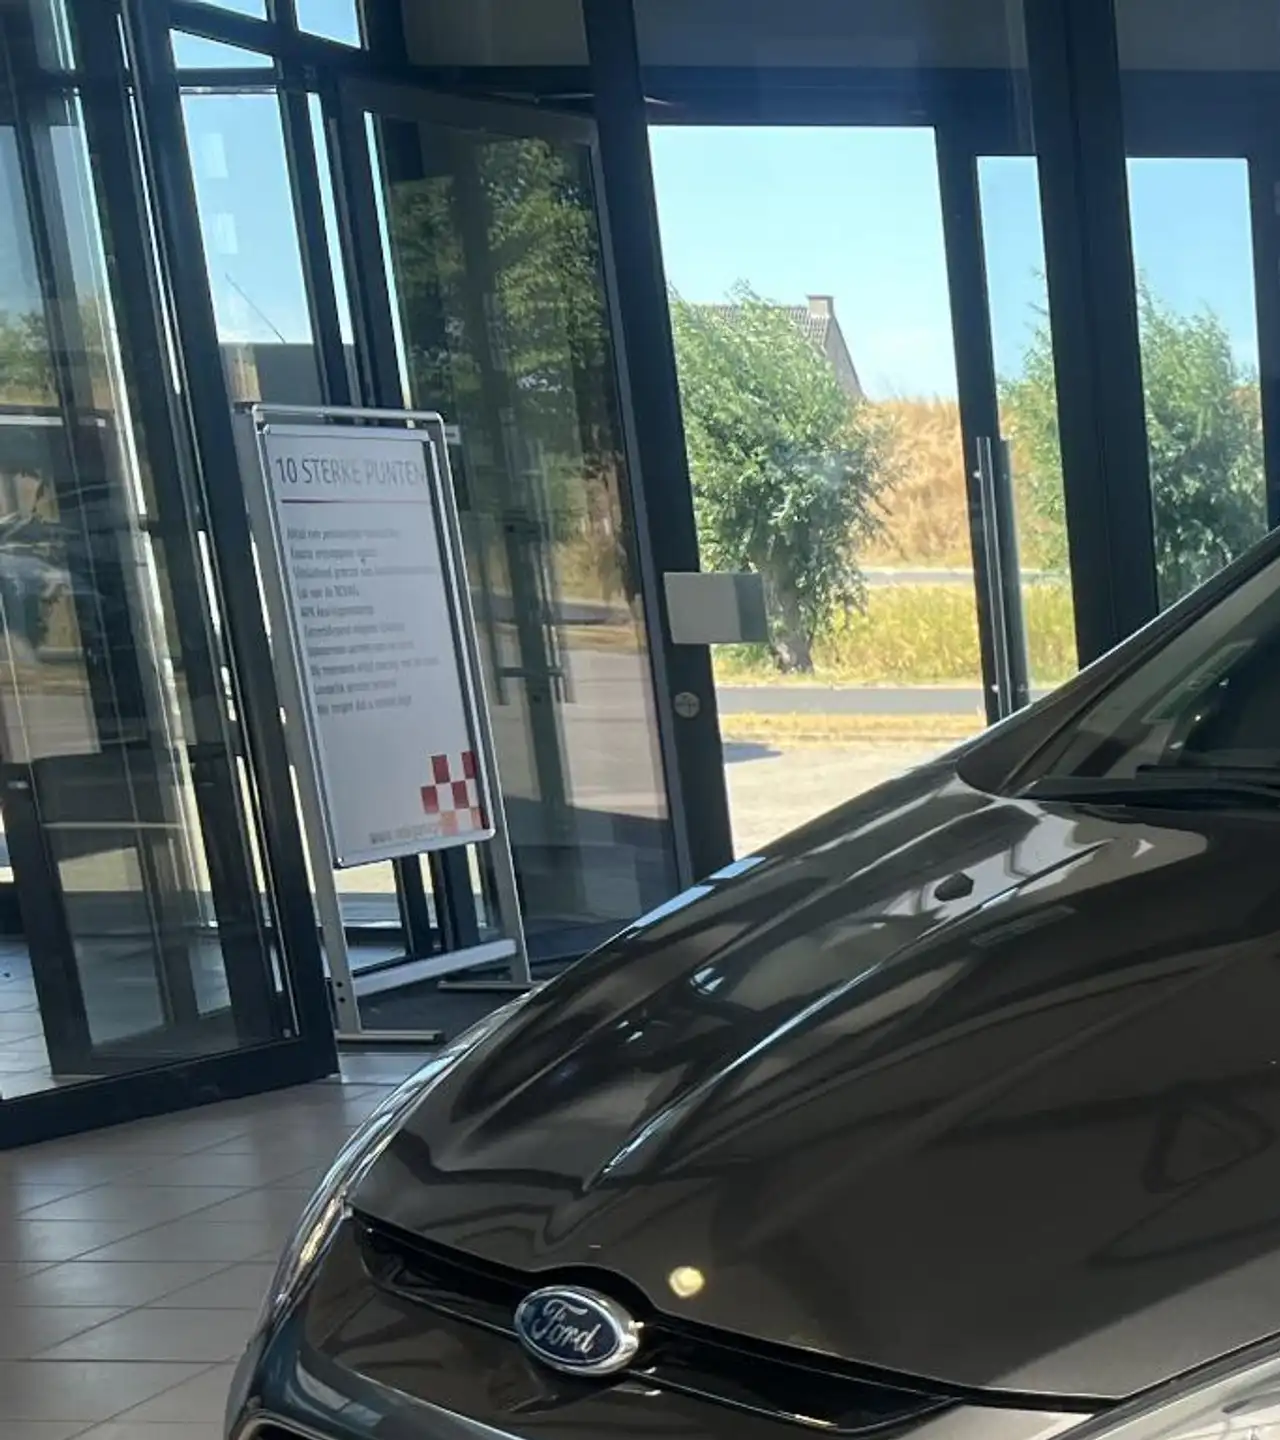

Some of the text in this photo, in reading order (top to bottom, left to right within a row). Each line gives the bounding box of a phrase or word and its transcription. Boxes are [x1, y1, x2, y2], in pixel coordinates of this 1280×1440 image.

[275, 457, 299, 484] 10
[302, 458, 361, 485] STERKE
[531, 1298, 601, 1353] Ford
